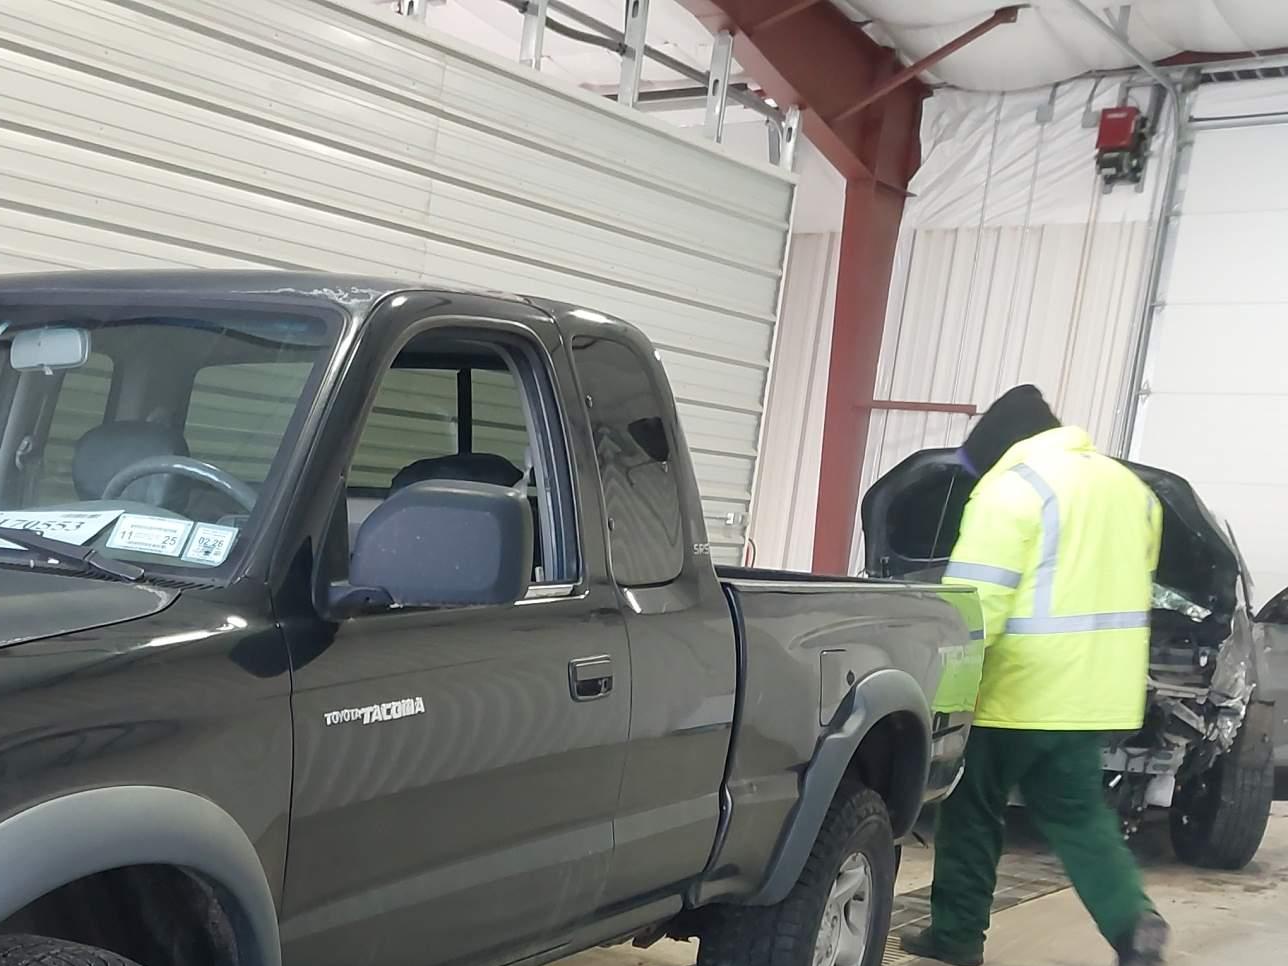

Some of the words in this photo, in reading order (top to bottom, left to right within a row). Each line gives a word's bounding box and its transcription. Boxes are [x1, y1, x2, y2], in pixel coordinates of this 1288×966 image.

[162, 535, 177, 546] 25
[323, 708, 361, 725] TOYOTA
[360, 697, 425, 725] TACOMA
